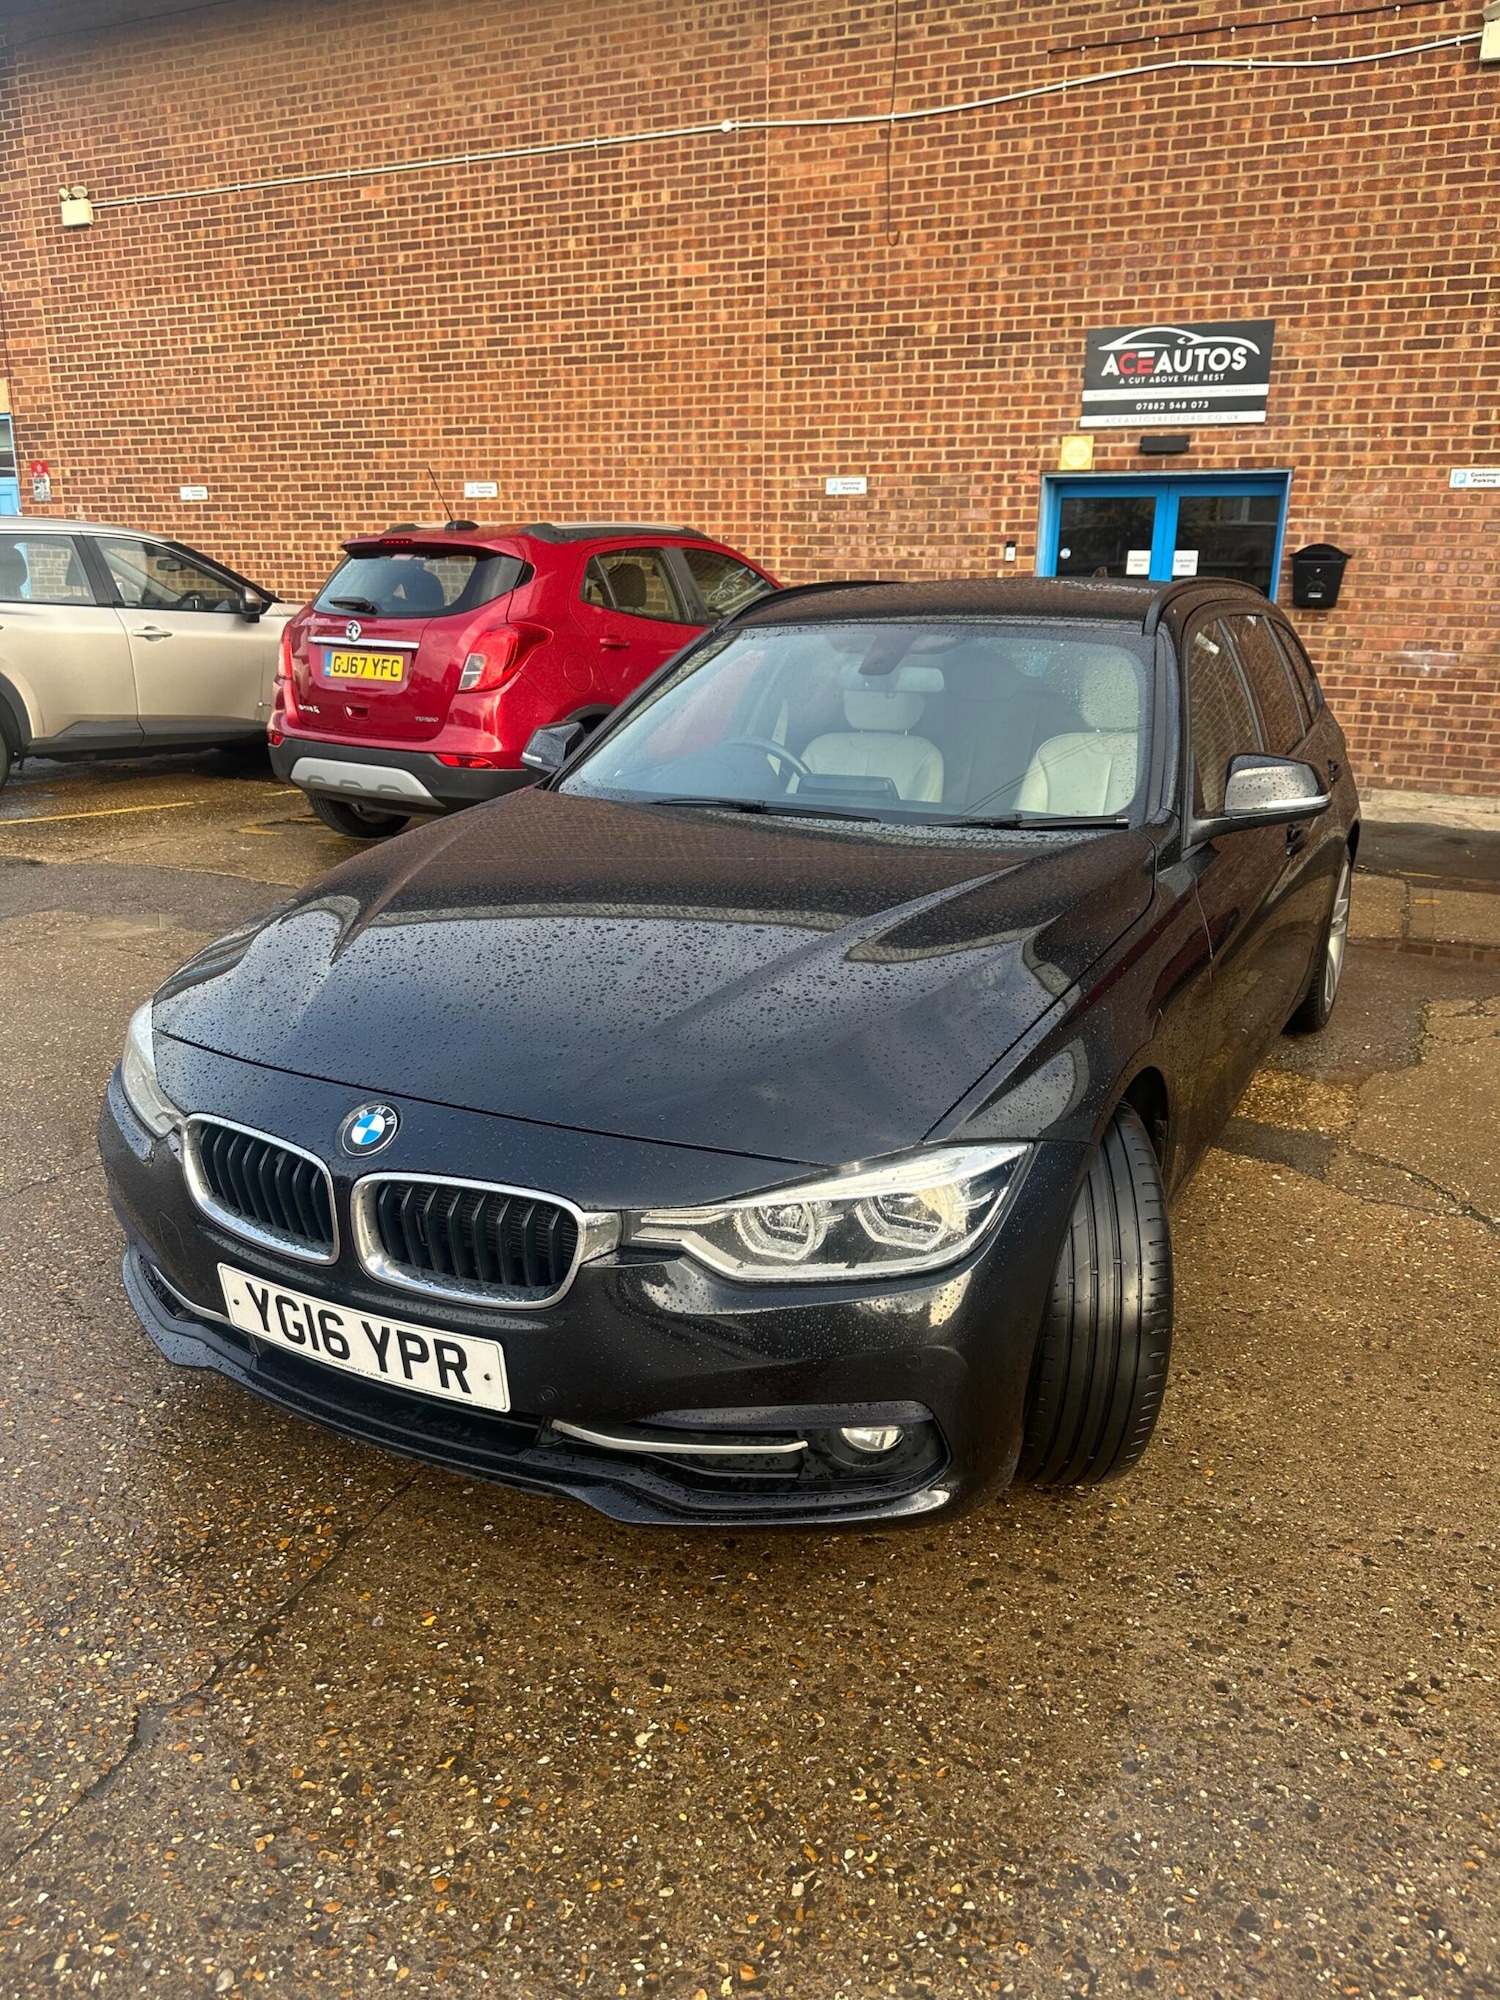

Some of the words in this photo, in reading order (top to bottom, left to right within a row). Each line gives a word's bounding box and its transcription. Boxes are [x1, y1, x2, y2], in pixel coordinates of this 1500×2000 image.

[1128, 376, 1146, 384] CUT
[1149, 375, 1179, 383] ABOVE
[1182, 374, 1199, 382] THE
[1203, 373, 1225, 382] REST
[1136, 402, 1165, 411] 07882
[1190, 400, 1209, 409] 073
[333, 655, 367, 676] GJ67
[372, 657, 400, 678] YFC
[245, 1281, 350, 1361] YG16
[361, 1320, 472, 1394] YPR
